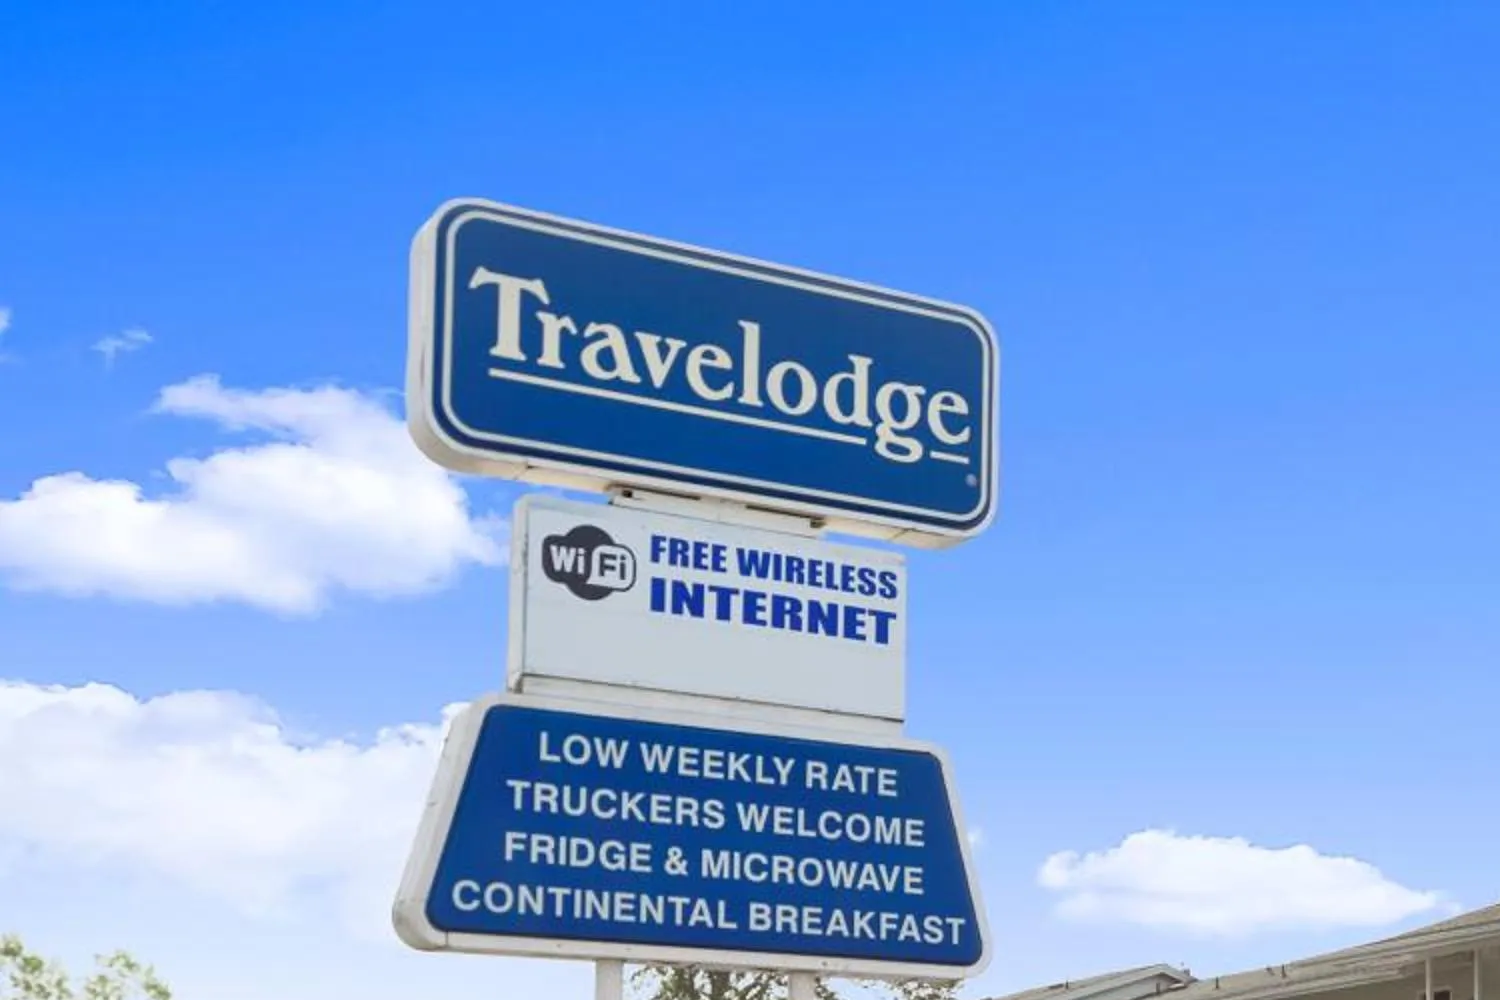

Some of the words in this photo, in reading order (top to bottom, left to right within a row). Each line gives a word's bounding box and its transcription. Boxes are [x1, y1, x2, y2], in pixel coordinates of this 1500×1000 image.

[468, 265, 971, 464] Travelodge
[650, 534, 728, 573] FREE
[736, 547, 898, 599] WIRELESS
[650, 577, 897, 645] INTERNET
[539, 731, 630, 770] LOW
[640, 742, 796, 786] WEEKLY
[804, 760, 898, 798] RATE
[506, 779, 725, 829] TRUCKERS
[736, 804, 925, 847] WELCOME
[504, 831, 652, 874] FRIDGE
[664, 847, 689, 877] &
[701, 850, 924, 895] MICROWAVE
[451, 880, 740, 930] CONTINENTAL
[748, 903, 966, 946] BREAKFAST
